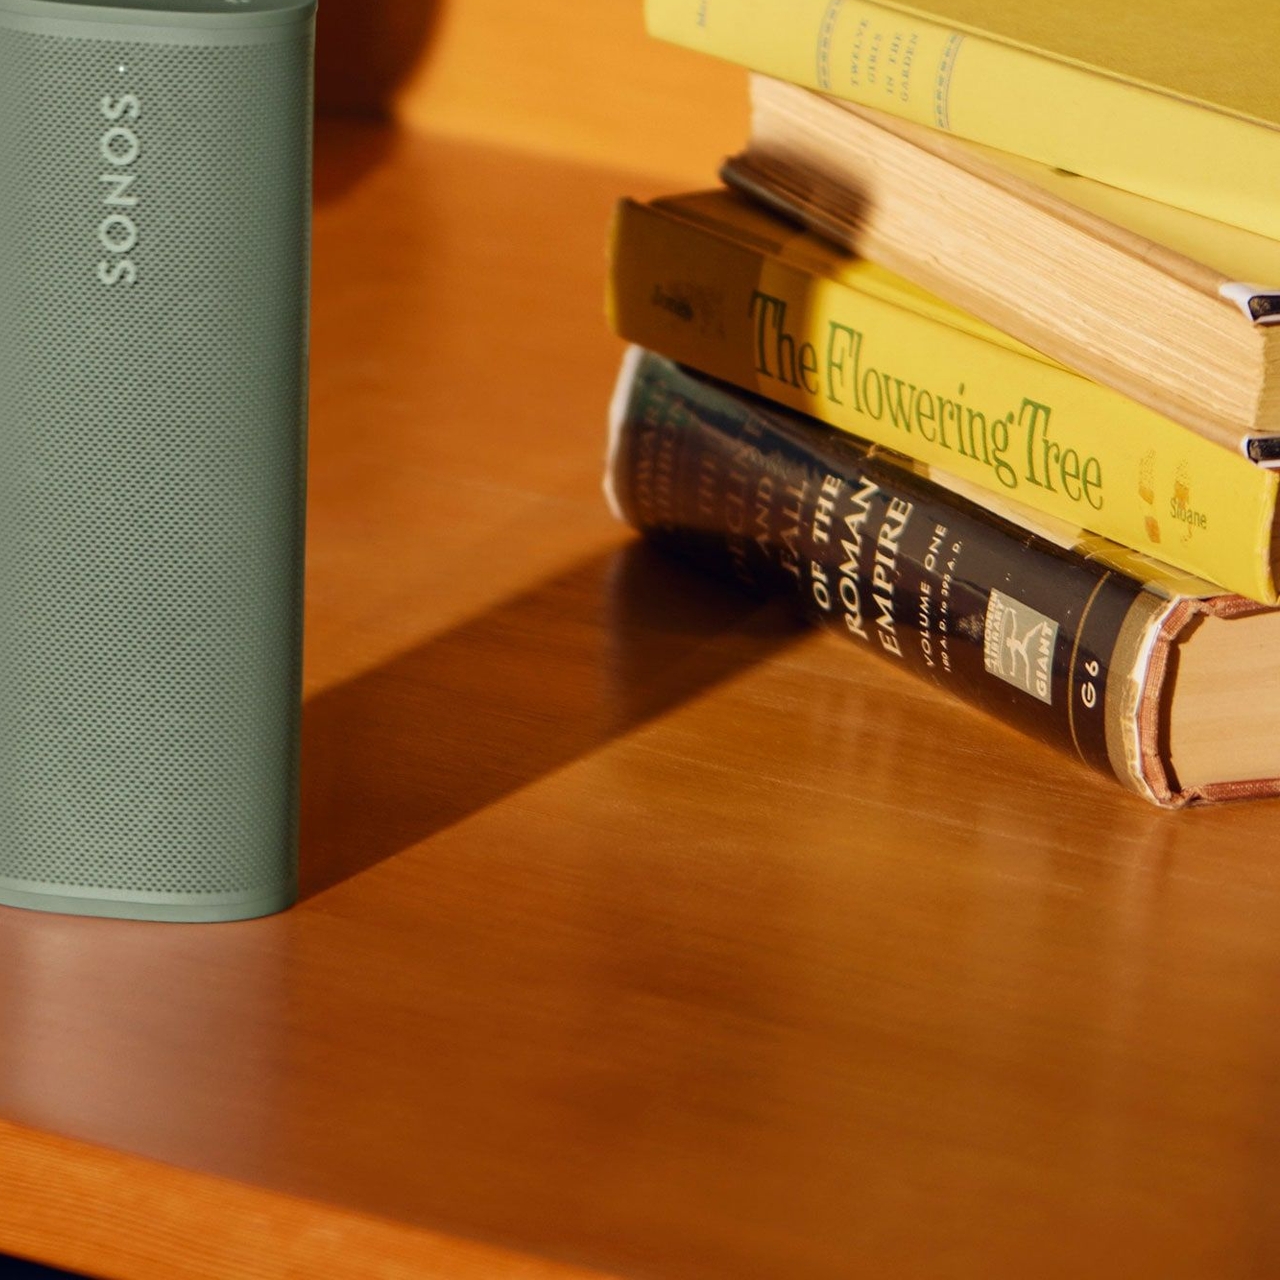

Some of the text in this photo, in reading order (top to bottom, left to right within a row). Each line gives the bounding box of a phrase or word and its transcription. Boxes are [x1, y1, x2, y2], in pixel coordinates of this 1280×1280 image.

[850, 19, 868, 86] TWELVE
[867, 34, 882, 84] GIRLS
[901, 32, 919, 102] GARDEN
[97, 94, 140, 285] SONOS
[748, 289, 1104, 511] The Flowering Tree
[810, 474, 842, 612] OF THE
[839, 475, 881, 641] ROMAN
[1169, 497, 1207, 530] Sloane
[872, 496, 915, 658] EMPIRE
[919, 523, 948, 667] VOLUME ONE
[1036, 621, 1053, 697] GIANT
[1081, 660, 1100, 708] G 6
